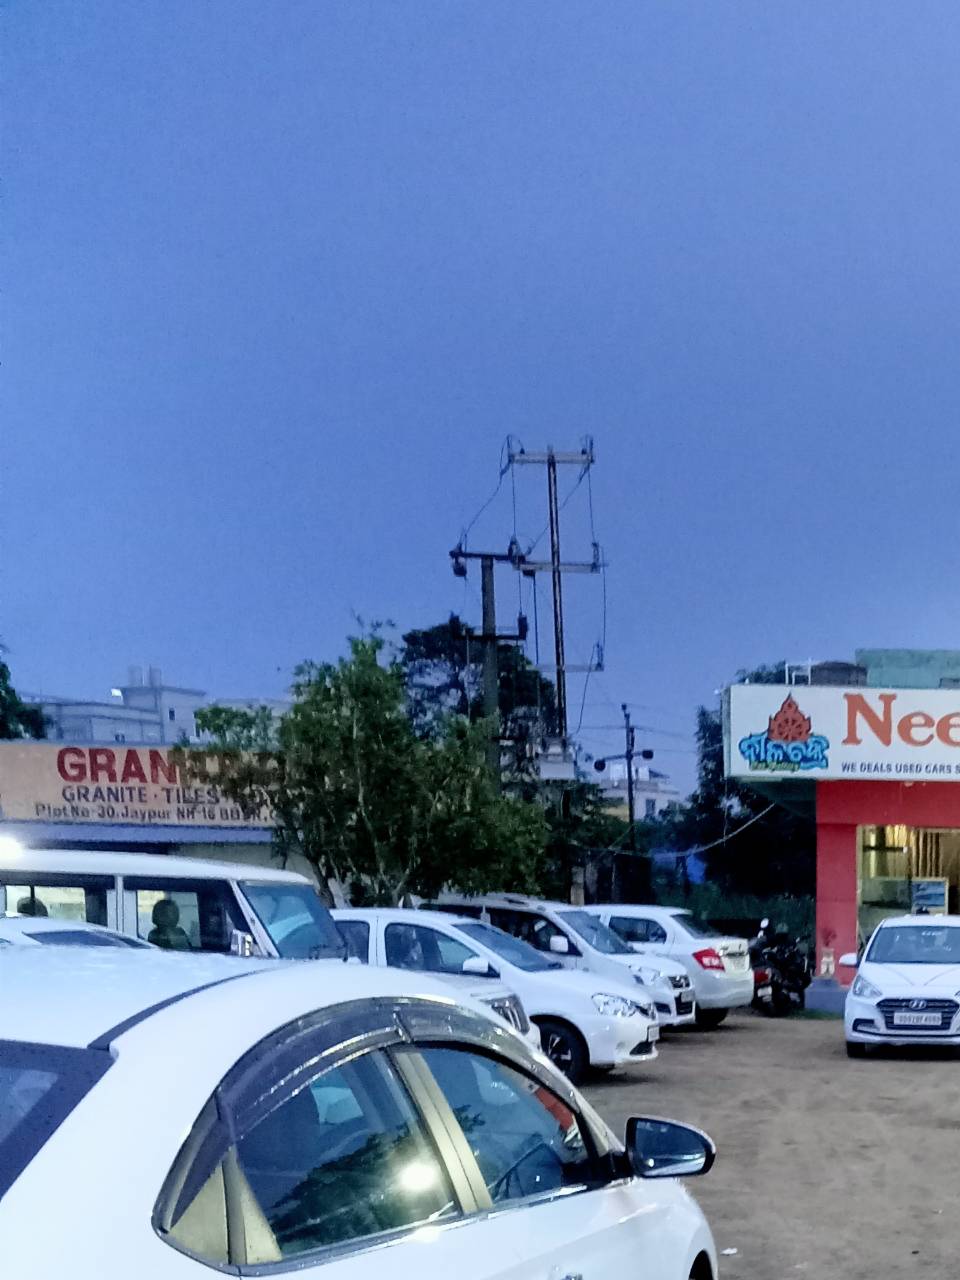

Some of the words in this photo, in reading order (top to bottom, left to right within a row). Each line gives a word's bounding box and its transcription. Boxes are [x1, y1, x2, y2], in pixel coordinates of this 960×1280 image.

[841, 762, 856, 773] WE
[860, 762, 892, 773] DEALS
[895, 763, 922, 774] USED
[925, 763, 951, 774] CARS
[62, 785, 148, 803] GRANITE
[162, 786, 220, 804] TILES
